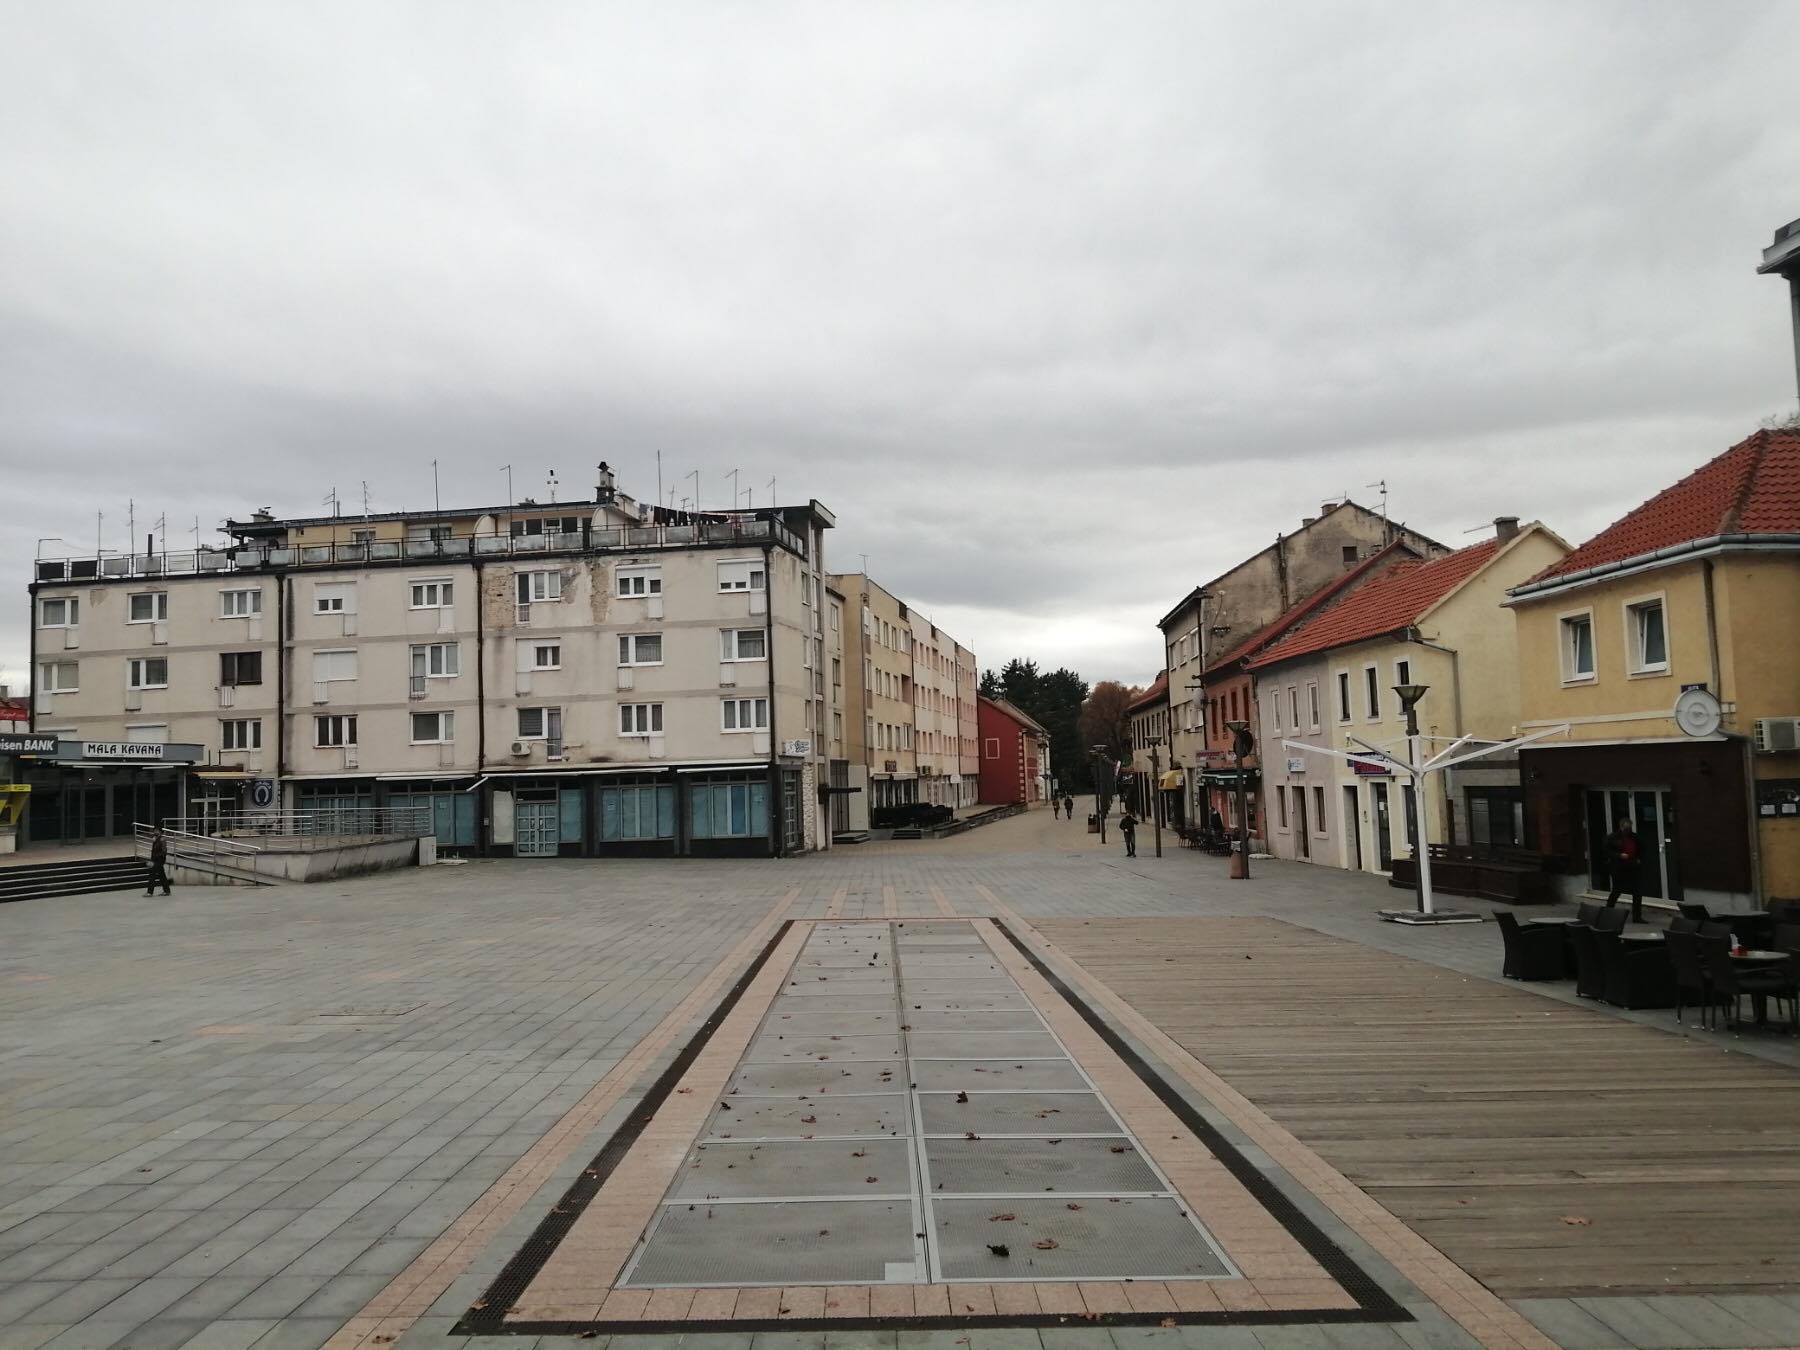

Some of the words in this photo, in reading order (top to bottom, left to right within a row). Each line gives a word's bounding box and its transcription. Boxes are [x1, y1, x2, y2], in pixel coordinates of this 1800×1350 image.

[0, 738, 22, 751] isen
[24, 739, 55, 751] BANK
[87, 743, 117, 754] MALA
[121, 744, 162, 755] KAVANA
